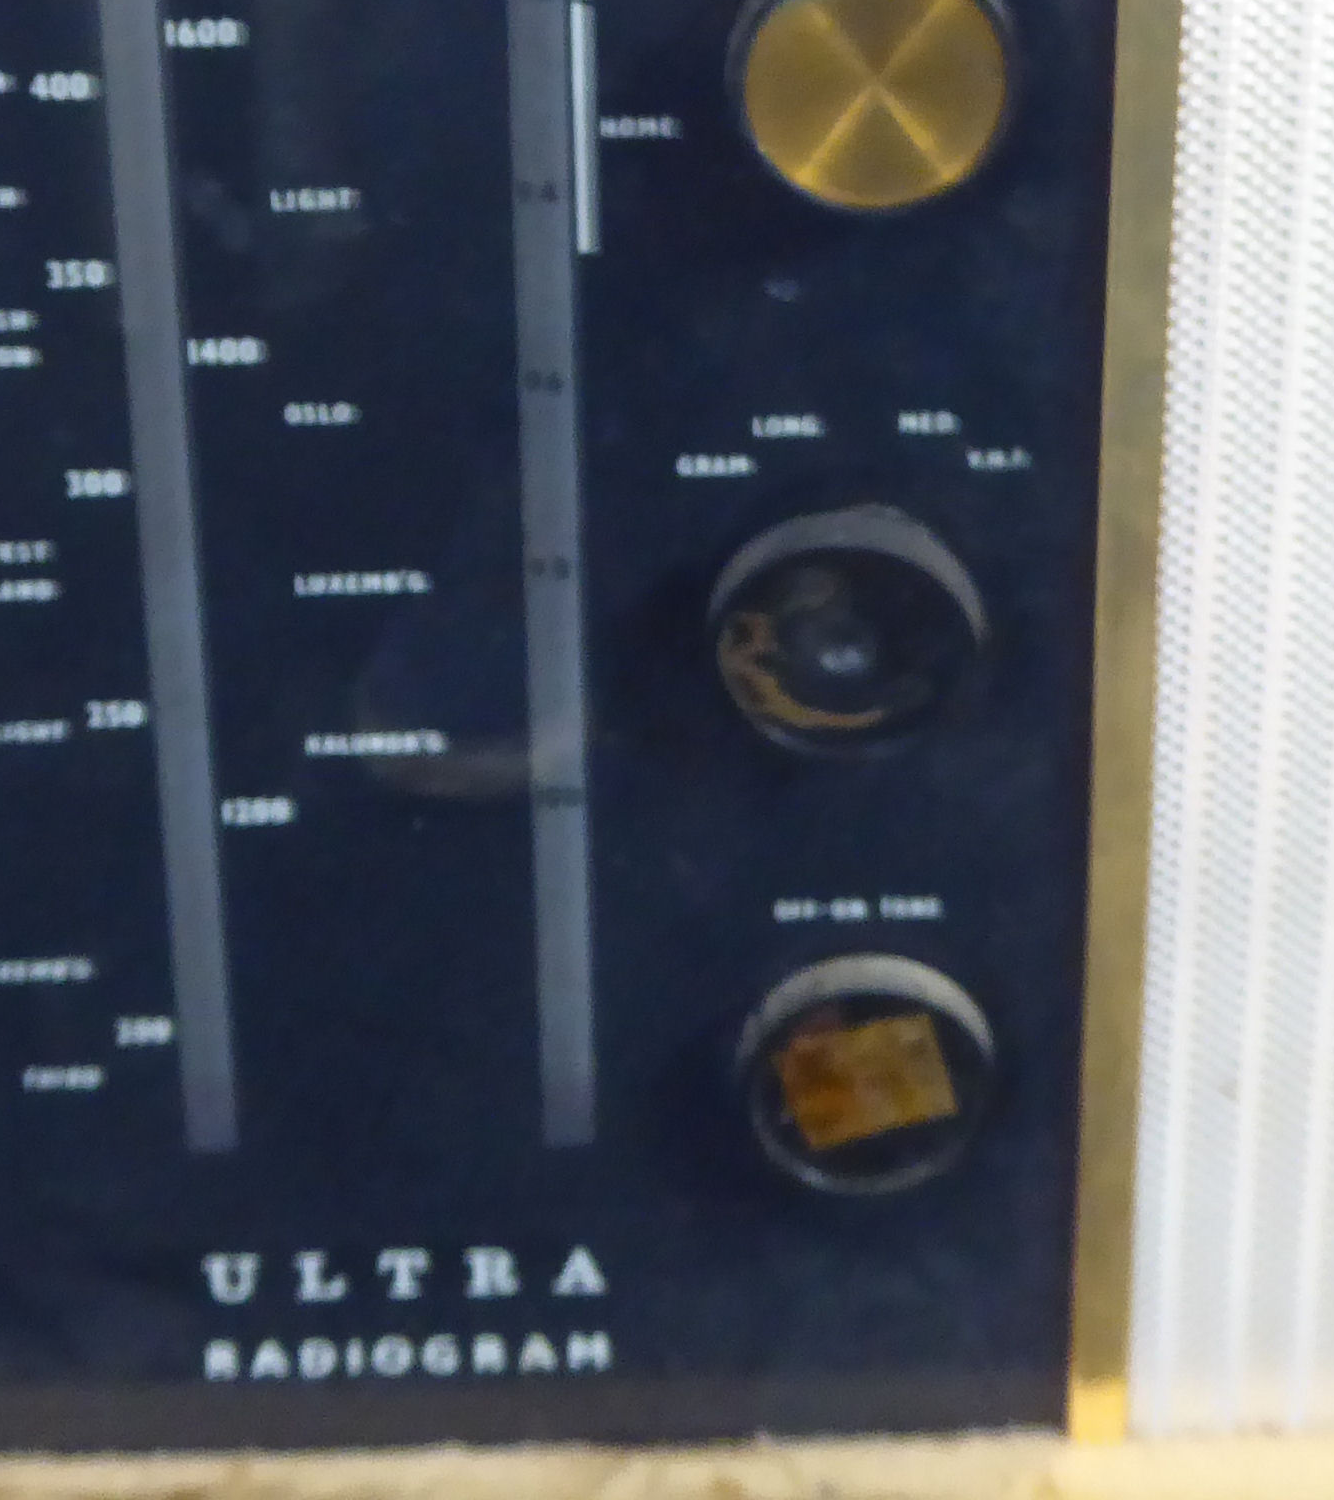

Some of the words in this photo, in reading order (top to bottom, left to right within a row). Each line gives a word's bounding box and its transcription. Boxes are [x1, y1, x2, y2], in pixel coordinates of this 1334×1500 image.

[165, 17, 247, 48] 1600
[30, 71, 98, 101] 400
[600, 116, 681, 140] HOME
[269, 186, 360, 212] LIGHT
[46, 258, 112, 289] 350
[187, 337, 266, 366] 1400
[283, 400, 359, 426] OSLO
[67, 467, 129, 498] 300
[201, 1246, 607, 1305] ULTRA
[204, 1330, 613, 1381] RADIOGRAM
